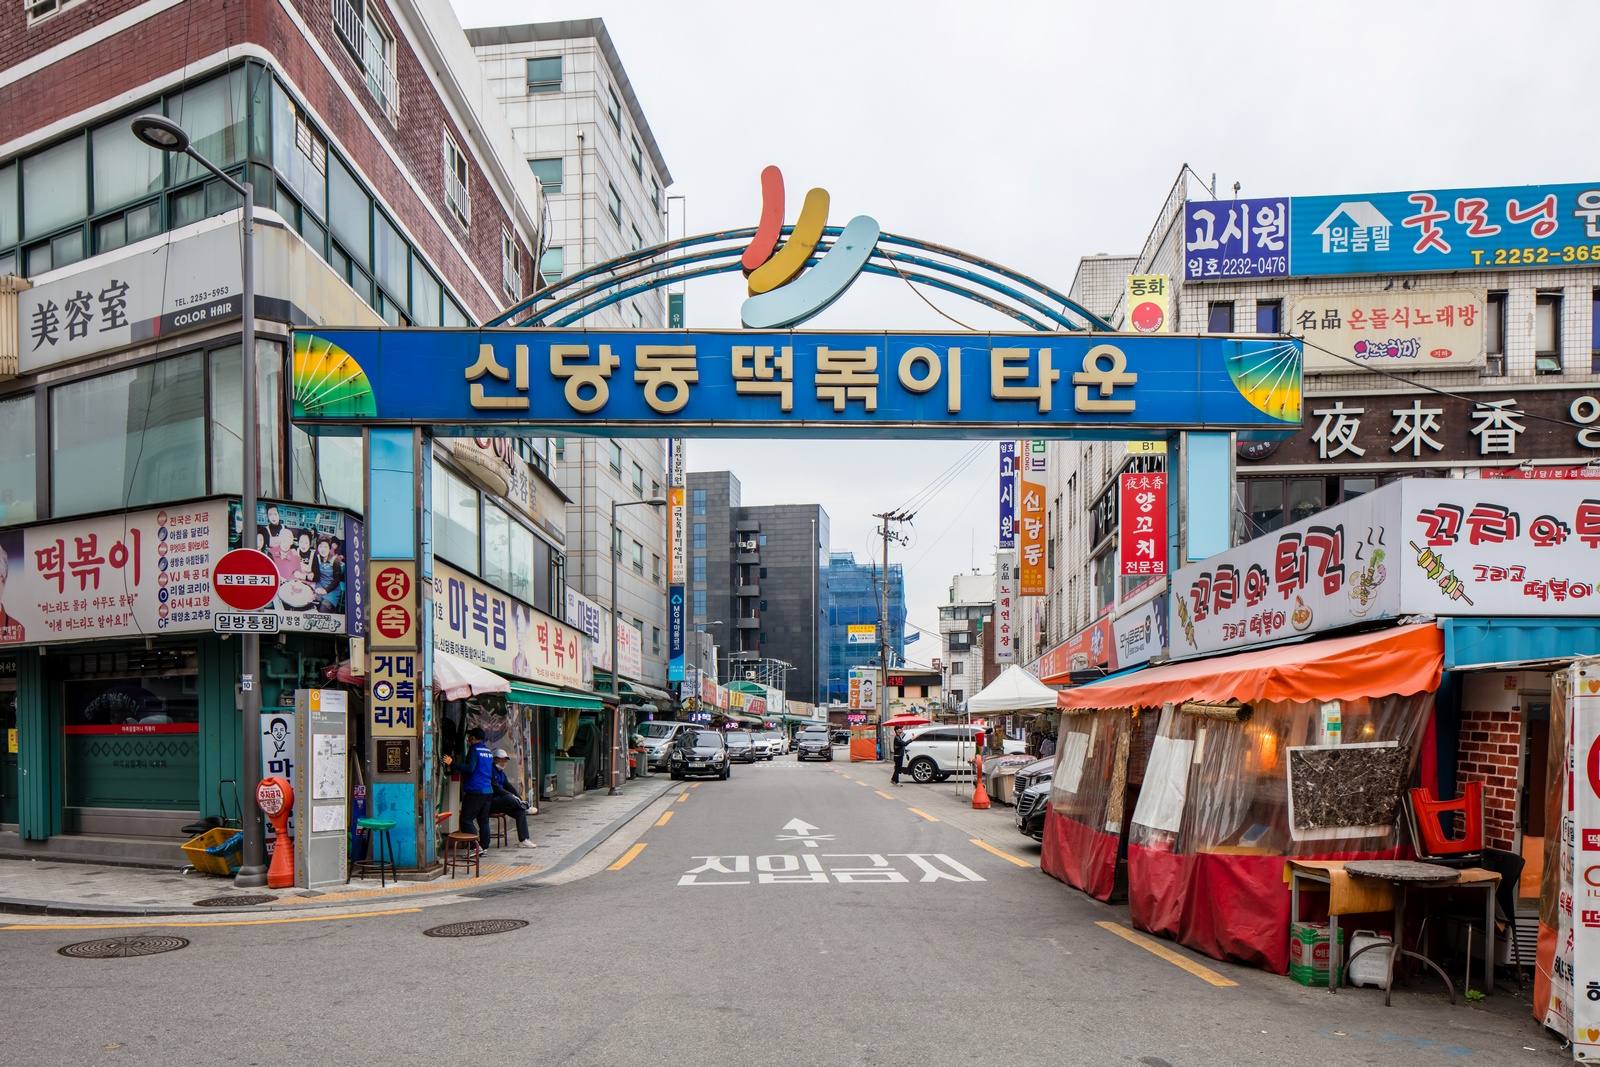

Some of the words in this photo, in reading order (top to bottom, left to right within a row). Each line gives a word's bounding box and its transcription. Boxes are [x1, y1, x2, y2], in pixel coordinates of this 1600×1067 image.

[1187, 203, 1286, 254] 고시원
[1401, 193, 1559, 254] 굿모닝
[1330, 226, 1390, 253] 원룸텔
[1188, 257, 1220, 277] 임호
[1223, 256, 1286, 275] 2232-0476
[1131, 278, 1164, 296] 동화
[31, 279, 130, 352] 美容室
[174, 309, 207, 327] COLOR
[210, 302, 232, 318] HAIR
[1296, 309, 1342, 331] 名品
[1346, 304, 1479, 330] 온돌식노래방
[465, 344, 699, 414] 신당동
[731, 344, 961, 413] 떡볶이
[990, 344, 1138, 413] 타운
[1310, 398, 1526, 459] 夜來香
[1142, 441, 1154, 450] B1
[1126, 475, 1165, 490] 夜來香
[1001, 456, 1014, 538] 고시원
[170, 515, 182, 527] 전국은
[194, 512, 209, 523] 지금
[1023, 490, 1044, 566] 신당동
[1133, 492, 1156, 560] 양꼬치
[170, 529, 188, 541] 아침을
[34, 528, 141, 594] 떡볶이
[1001, 563, 1010, 580] 名品
[1126, 561, 1164, 574] 전문점
[1275, 524, 1345, 600] 튀김
[1473, 564, 1526, 582] 그리고
[170, 571, 180, 582] VJ
[170, 584, 185, 596] 리얼
[187, 582, 210, 594] 코리아
[223, 575, 271, 585] 진입금지
[1523, 577, 1593, 602] 떡볶이
[381, 573, 405, 634] 경축
[448, 577, 506, 651] 마복림
[1000, 586, 1010, 646] 노래연습장
[158, 618, 169, 628] CF
[218, 616, 275, 630] 일방통행
[286, 616, 300, 626] 방영
[1222, 619, 1247, 641] 그리고
[1250, 608, 1286, 638] 떡볶이
[537, 621, 578, 674] 떡볶이
[396, 656, 414, 728] 대축제
[677, 853, 987, 885] 진입금지
